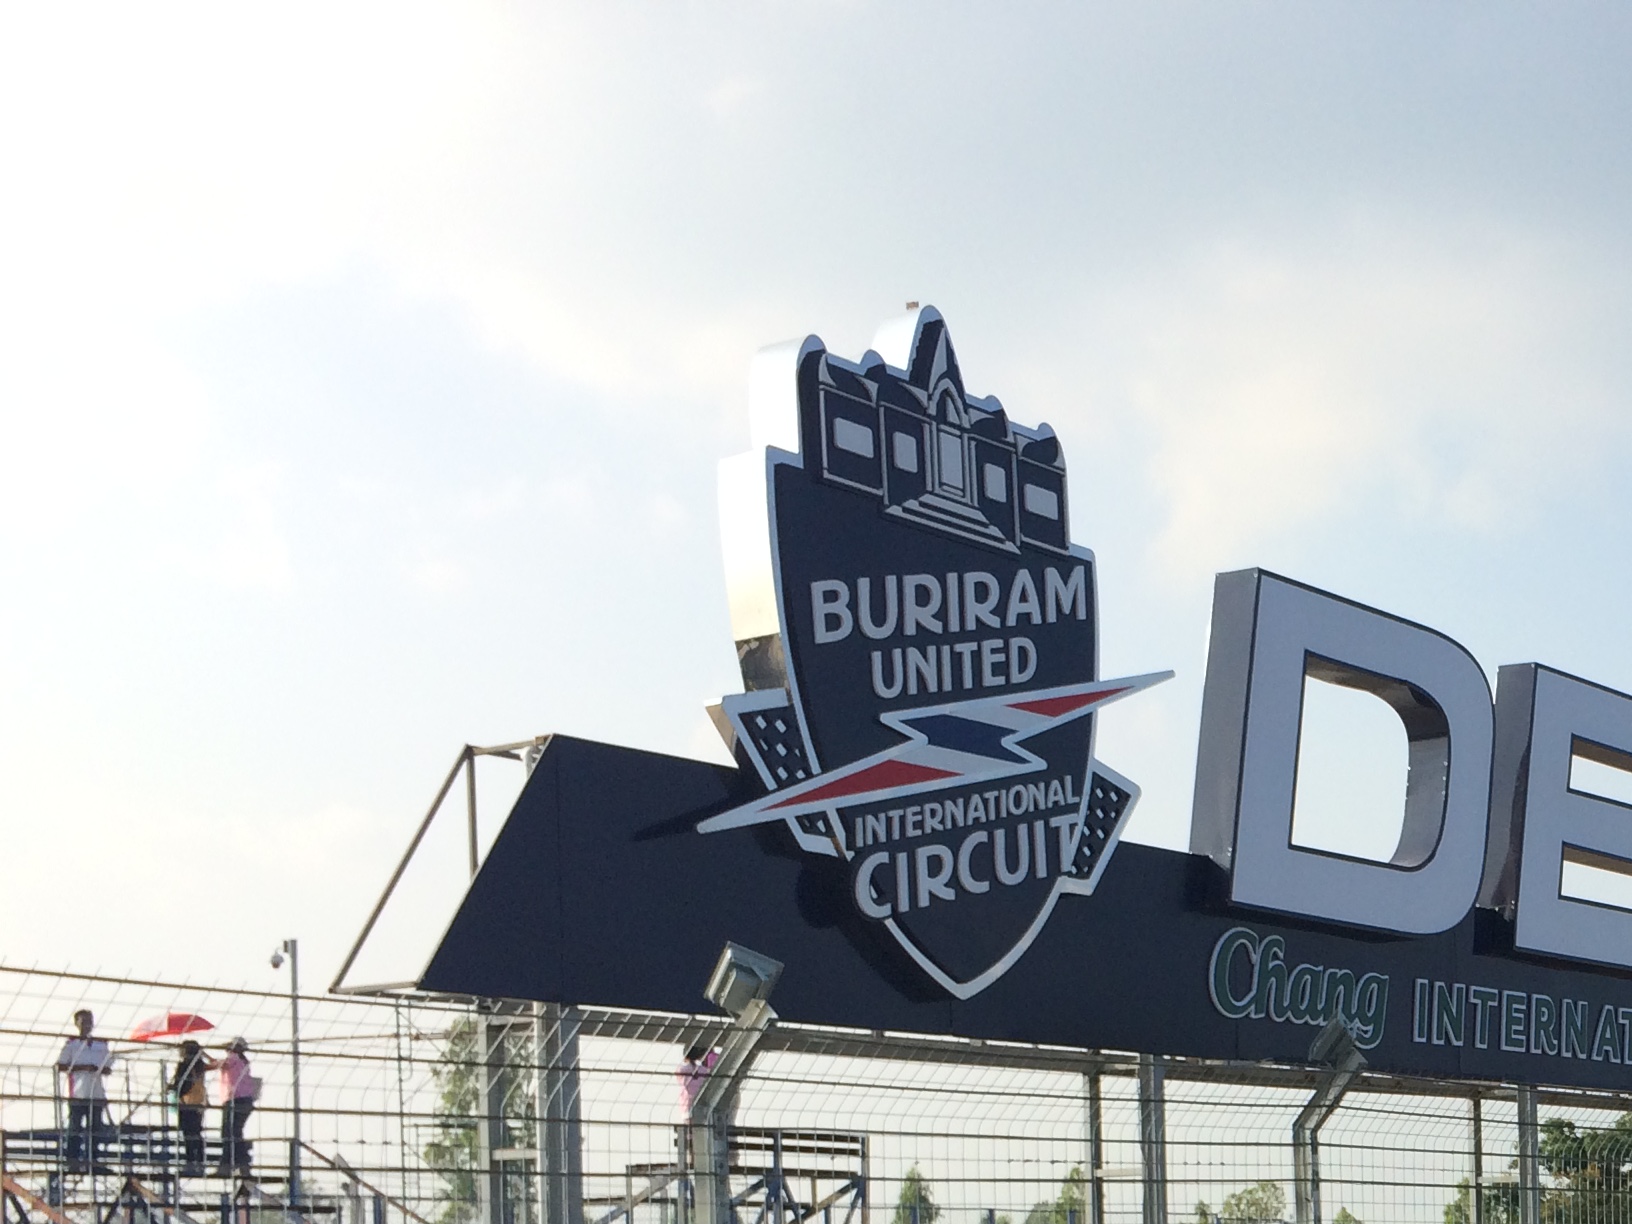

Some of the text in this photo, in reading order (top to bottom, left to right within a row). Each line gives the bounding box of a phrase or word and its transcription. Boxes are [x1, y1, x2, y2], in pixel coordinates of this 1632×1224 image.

[809, 565, 1087, 645] BURIRAM
[870, 636, 1038, 700] UNITED
[854, 774, 1081, 848] INTERNATIONAL
[854, 814, 1081, 920] CIRCUIT
[1208, 926, 1389, 1050] Chang
